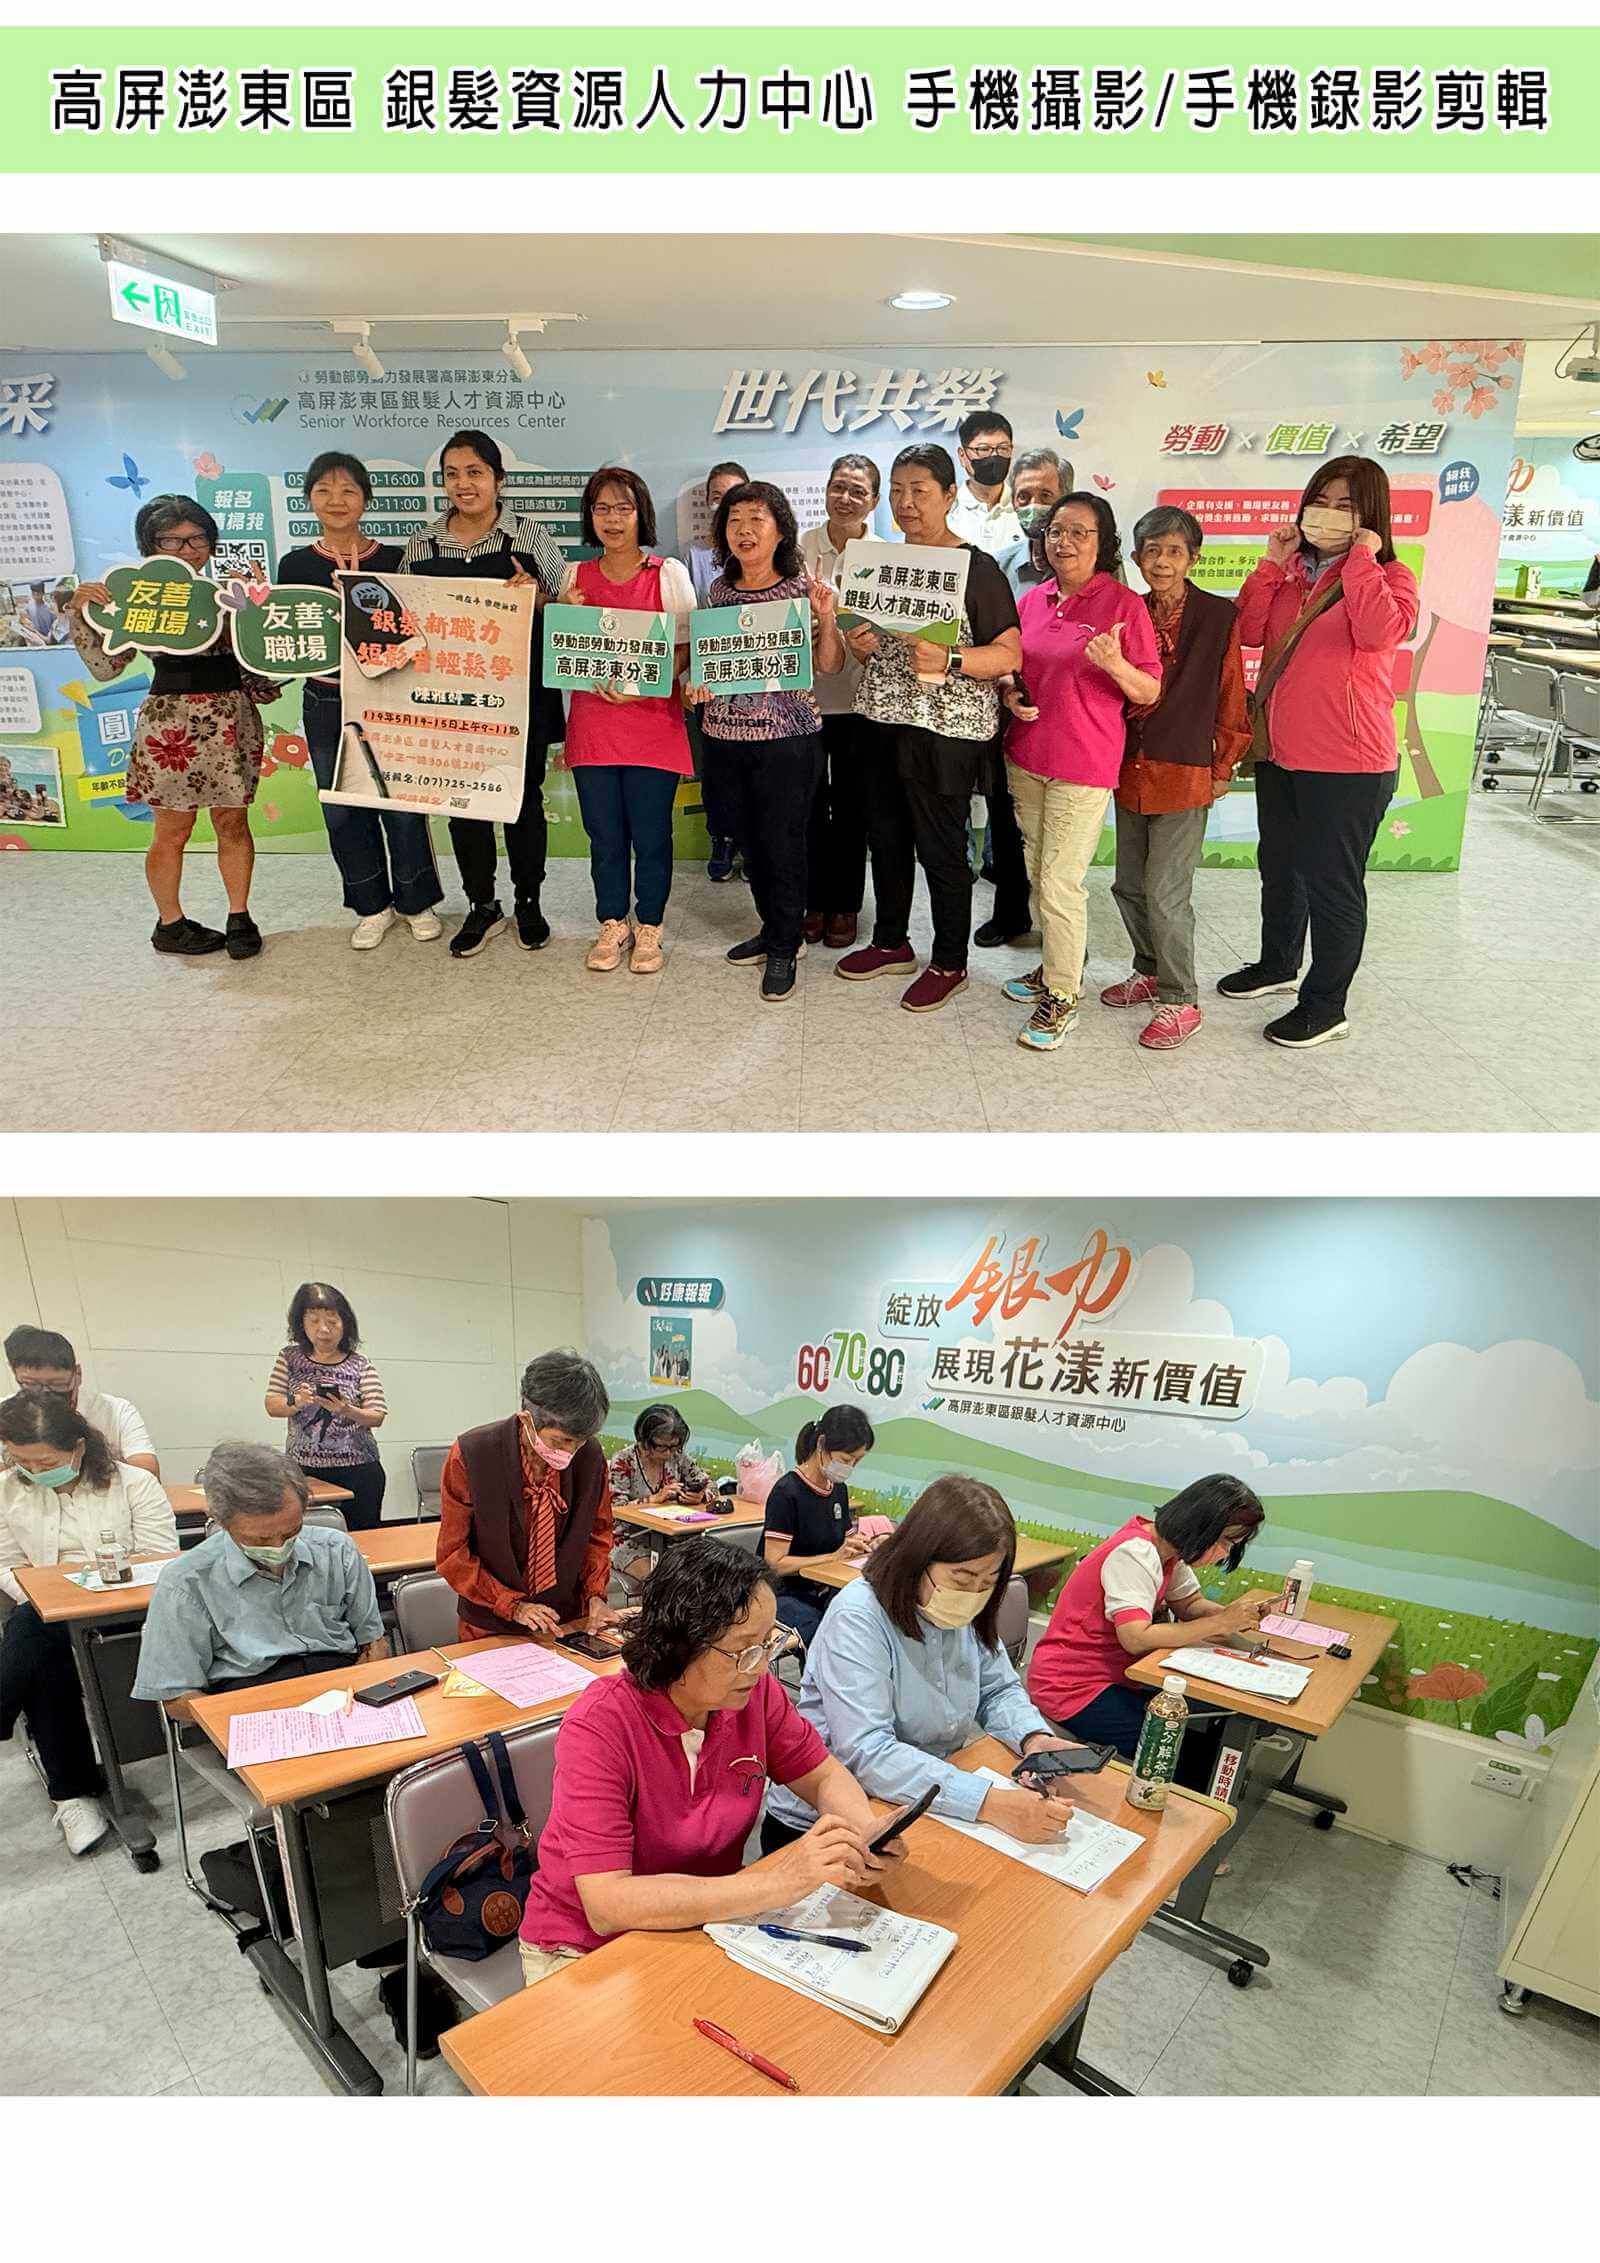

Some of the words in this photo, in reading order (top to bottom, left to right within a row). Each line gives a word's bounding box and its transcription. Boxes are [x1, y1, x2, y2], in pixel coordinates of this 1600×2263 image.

[298, 391, 566, 411] 高屏澎東區銀髮人才資源中心
[713, 368, 1003, 433] 世代共榮
[300, 415, 345, 429] Senior
[354, 414, 429, 428] Workforce
[438, 415, 510, 429] Resources
[519, 415, 566, 428] Center
[1160, 424, 1226, 452] 勞動
[1265, 423, 1332, 452] 價值
[1376, 423, 1443, 452] 希望
[214, 490, 252, 508] 報名
[878, 564, 959, 594] 高屏澎東區
[126, 580, 193, 608] 友善
[843, 589, 954, 622] 銀髮人才資源中心
[122, 607, 190, 635] 職場
[261, 602, 325, 631] 友善
[263, 634, 329, 664] 職場
[552, 632, 668, 657] 勞動部勞動力發展署
[697, 630, 804, 656] 勞動部勞動力發展署
[556, 655, 660, 684] 高屏澎東分署
[703, 654, 799, 683] 高屏澎東分署
[885, 1291, 944, 1329] 綻放
[797, 1344, 832, 1393] 60
[832, 1331, 867, 1381] 70
[867, 1346, 906, 1398] 80
[931, 1335, 1247, 1409] 展現花漾新價值
[947, 1398, 1127, 1434] 高屏澎東區銀髮人才資源中心
